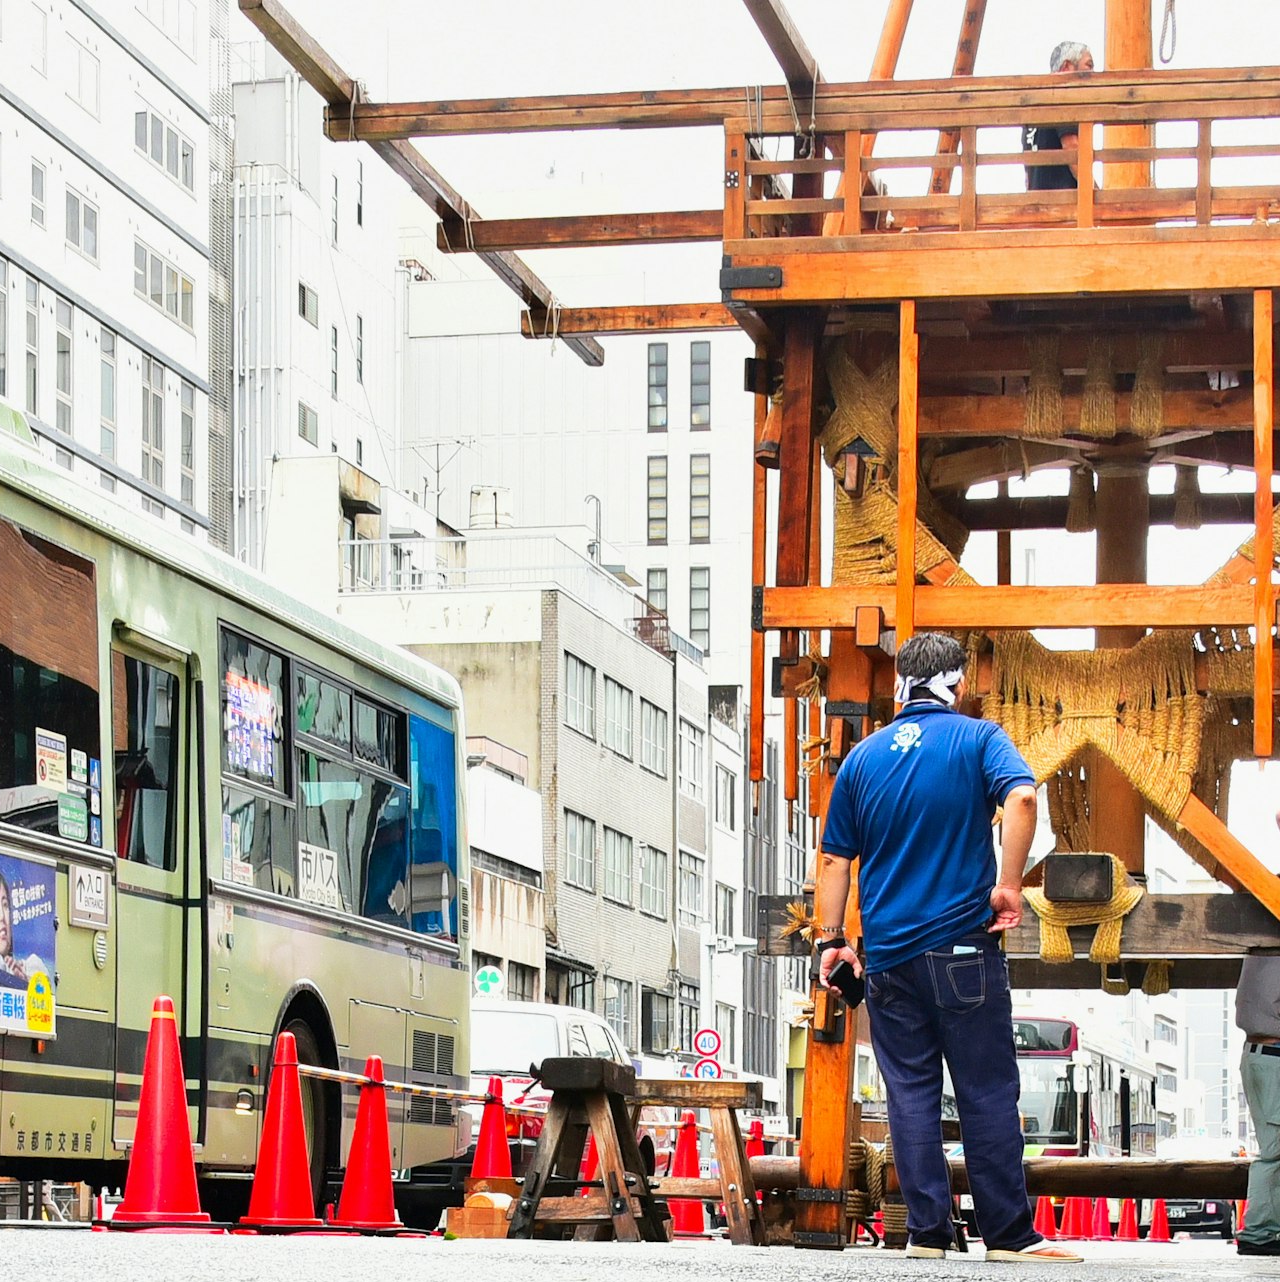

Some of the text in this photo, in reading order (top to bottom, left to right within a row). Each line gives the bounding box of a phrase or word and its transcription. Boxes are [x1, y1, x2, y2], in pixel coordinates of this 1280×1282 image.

[301, 845, 336, 889] 市バス
[86, 873, 102, 894] 入口
[700, 1036, 716, 1049] 40
[17, 1129, 93, 1154] 京都市交通局
